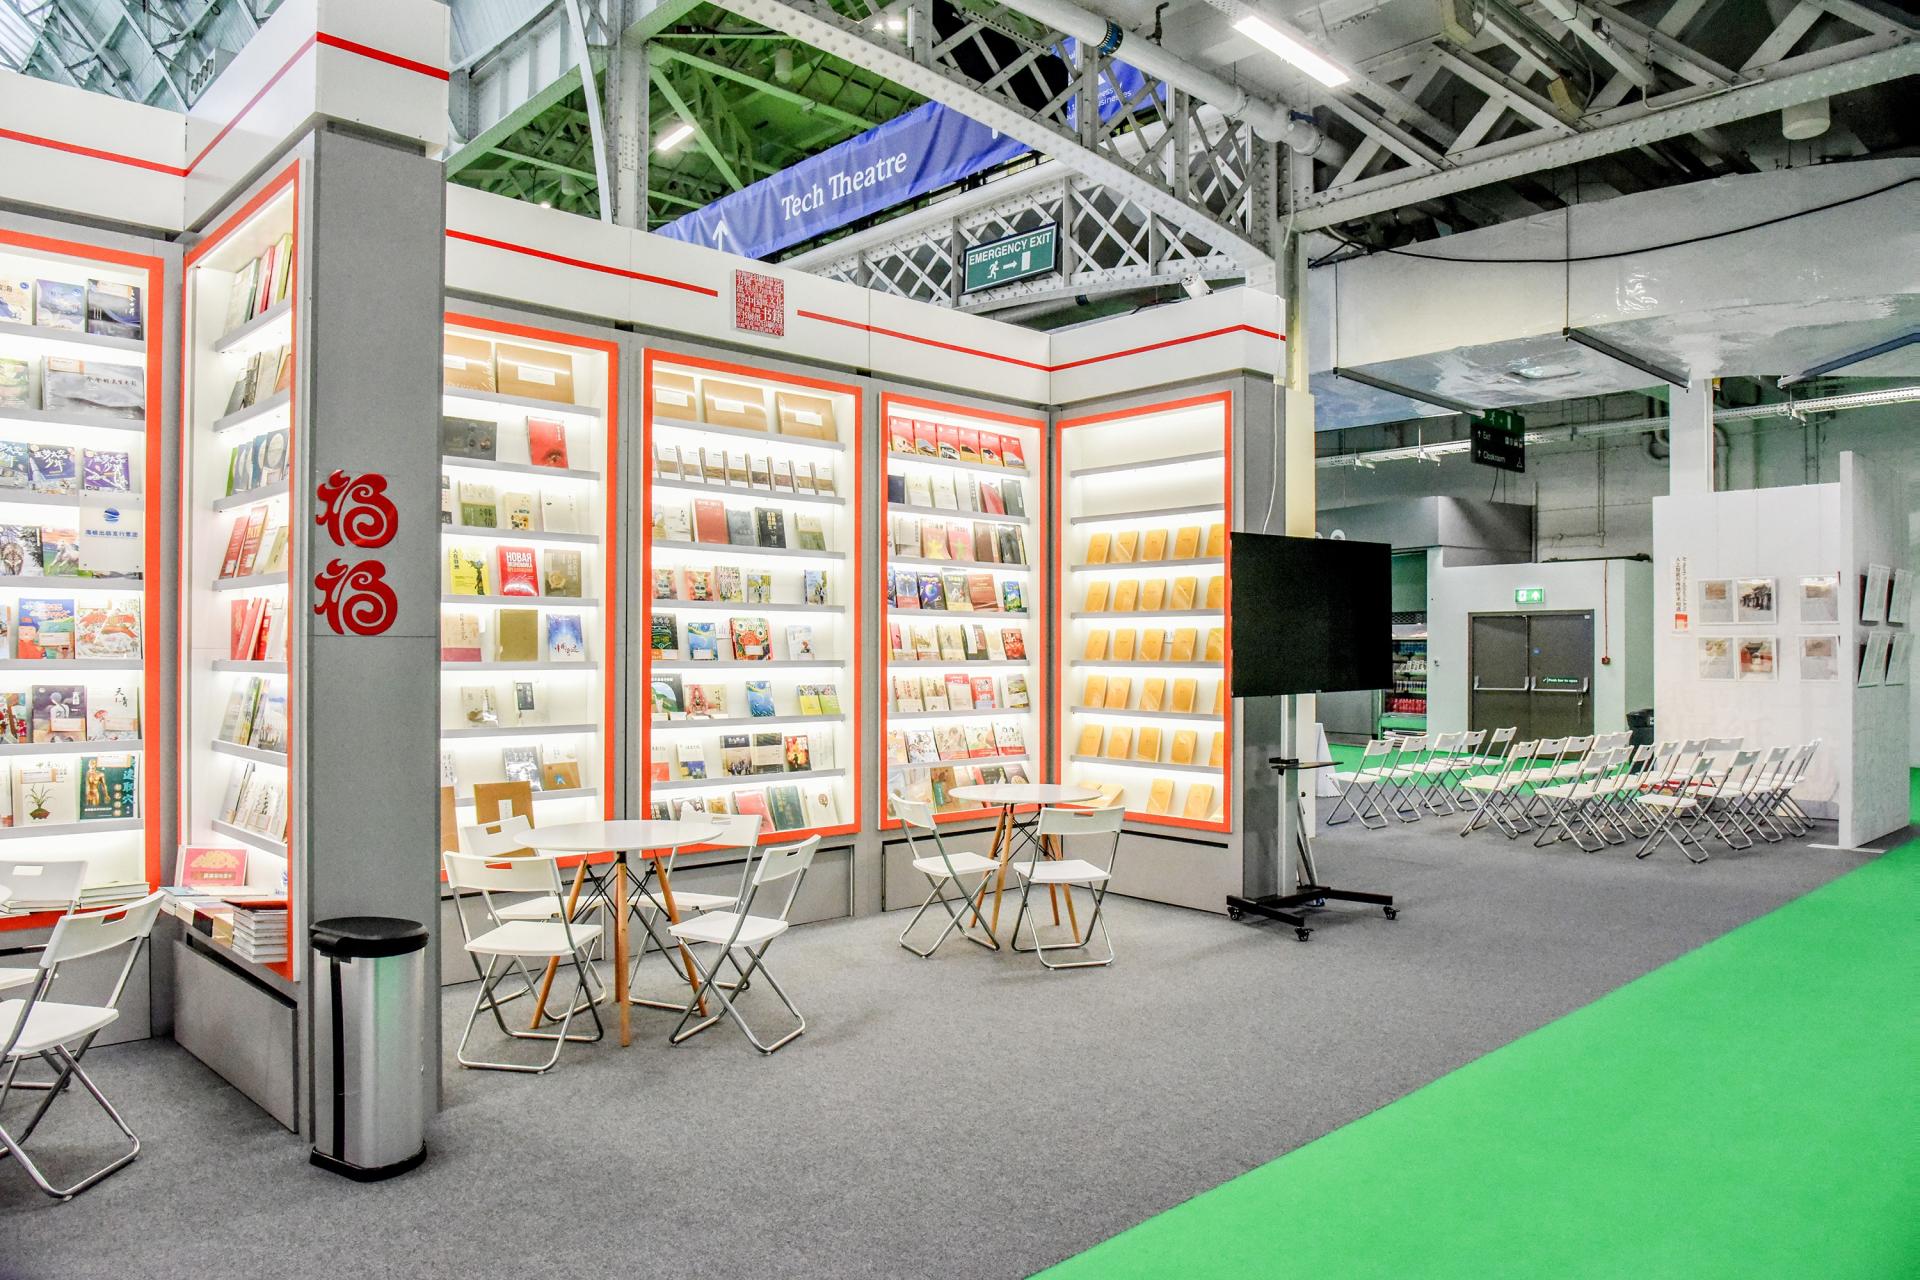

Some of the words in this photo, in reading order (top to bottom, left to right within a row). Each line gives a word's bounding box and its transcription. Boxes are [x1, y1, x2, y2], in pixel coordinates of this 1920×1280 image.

[781, 183, 824, 220] Tech
[828, 152, 907, 201] Theatre
[969, 239, 1028, 265] EMERGENCY
[1029, 231, 1052, 248] EXIT
[505, 551, 532, 563] НОВАЯ
